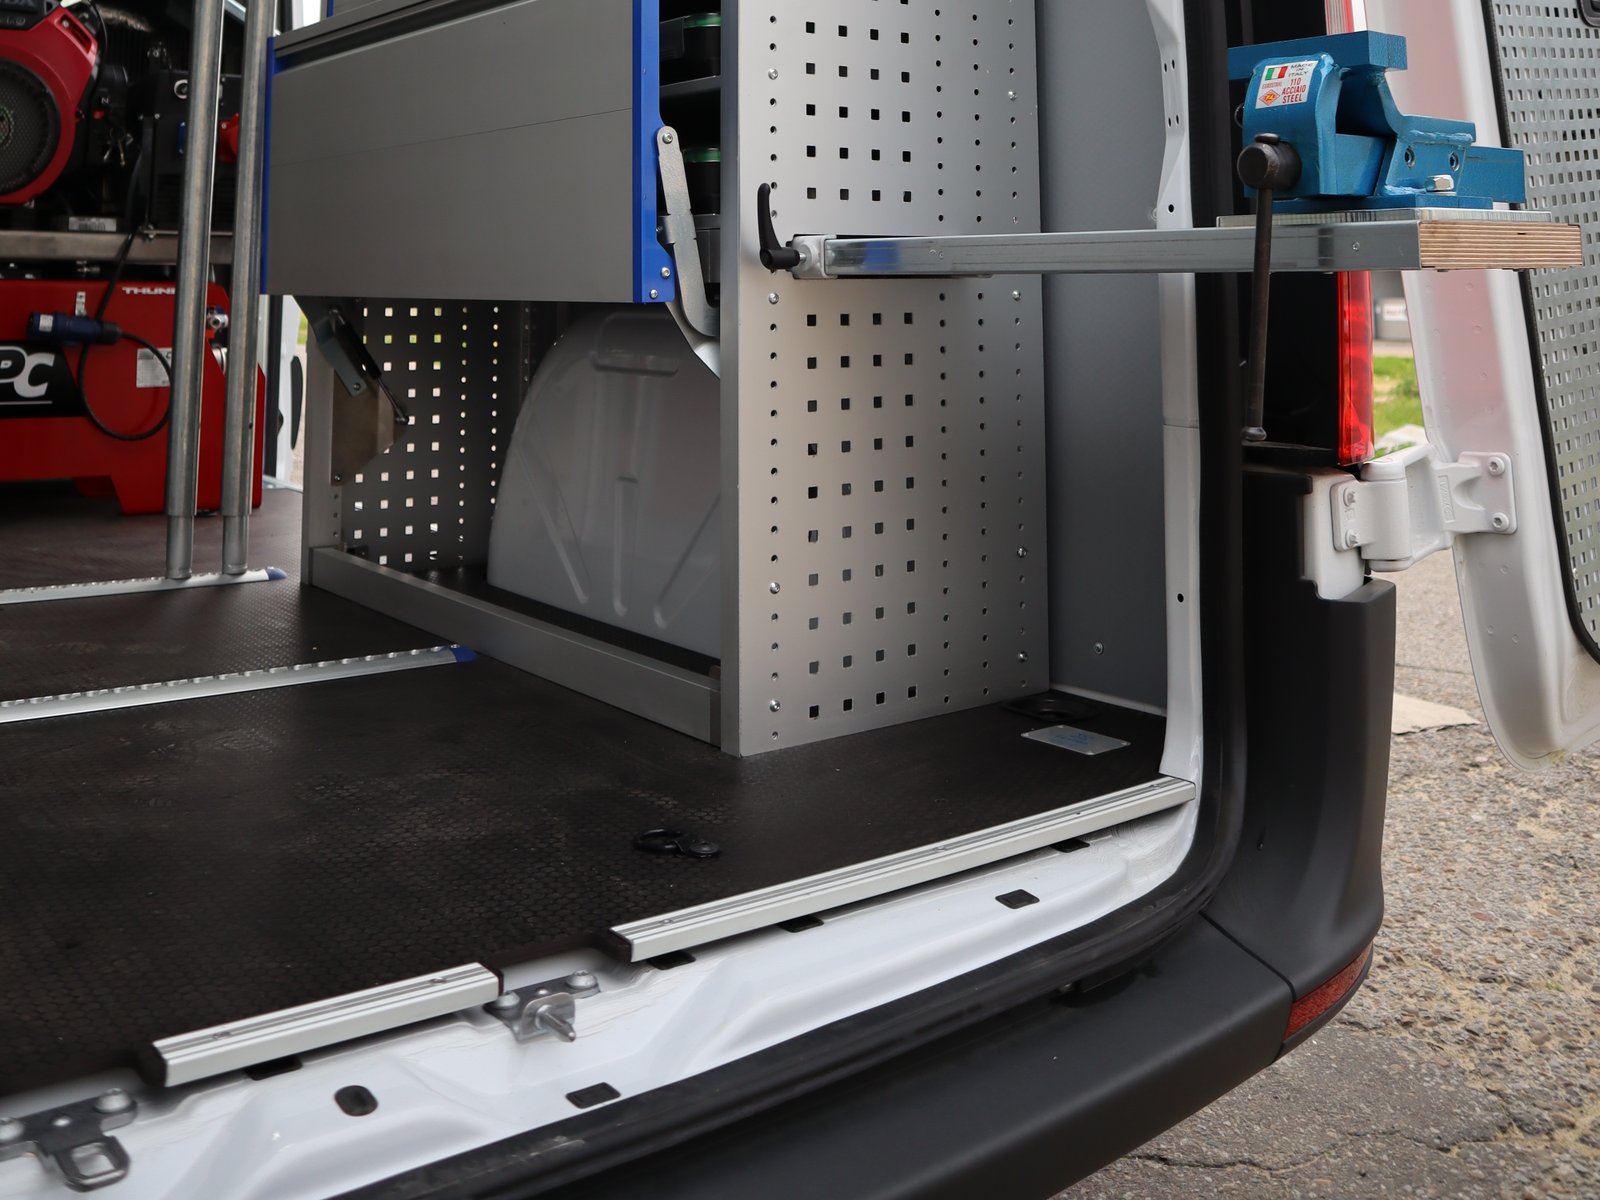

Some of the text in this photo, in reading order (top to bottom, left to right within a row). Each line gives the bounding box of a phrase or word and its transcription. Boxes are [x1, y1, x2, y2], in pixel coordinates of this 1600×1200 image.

[1282, 85, 1306, 95] ACCIAIO
[1282, 94, 1302, 104] STEEL
[122, 286, 176, 295] THUN
